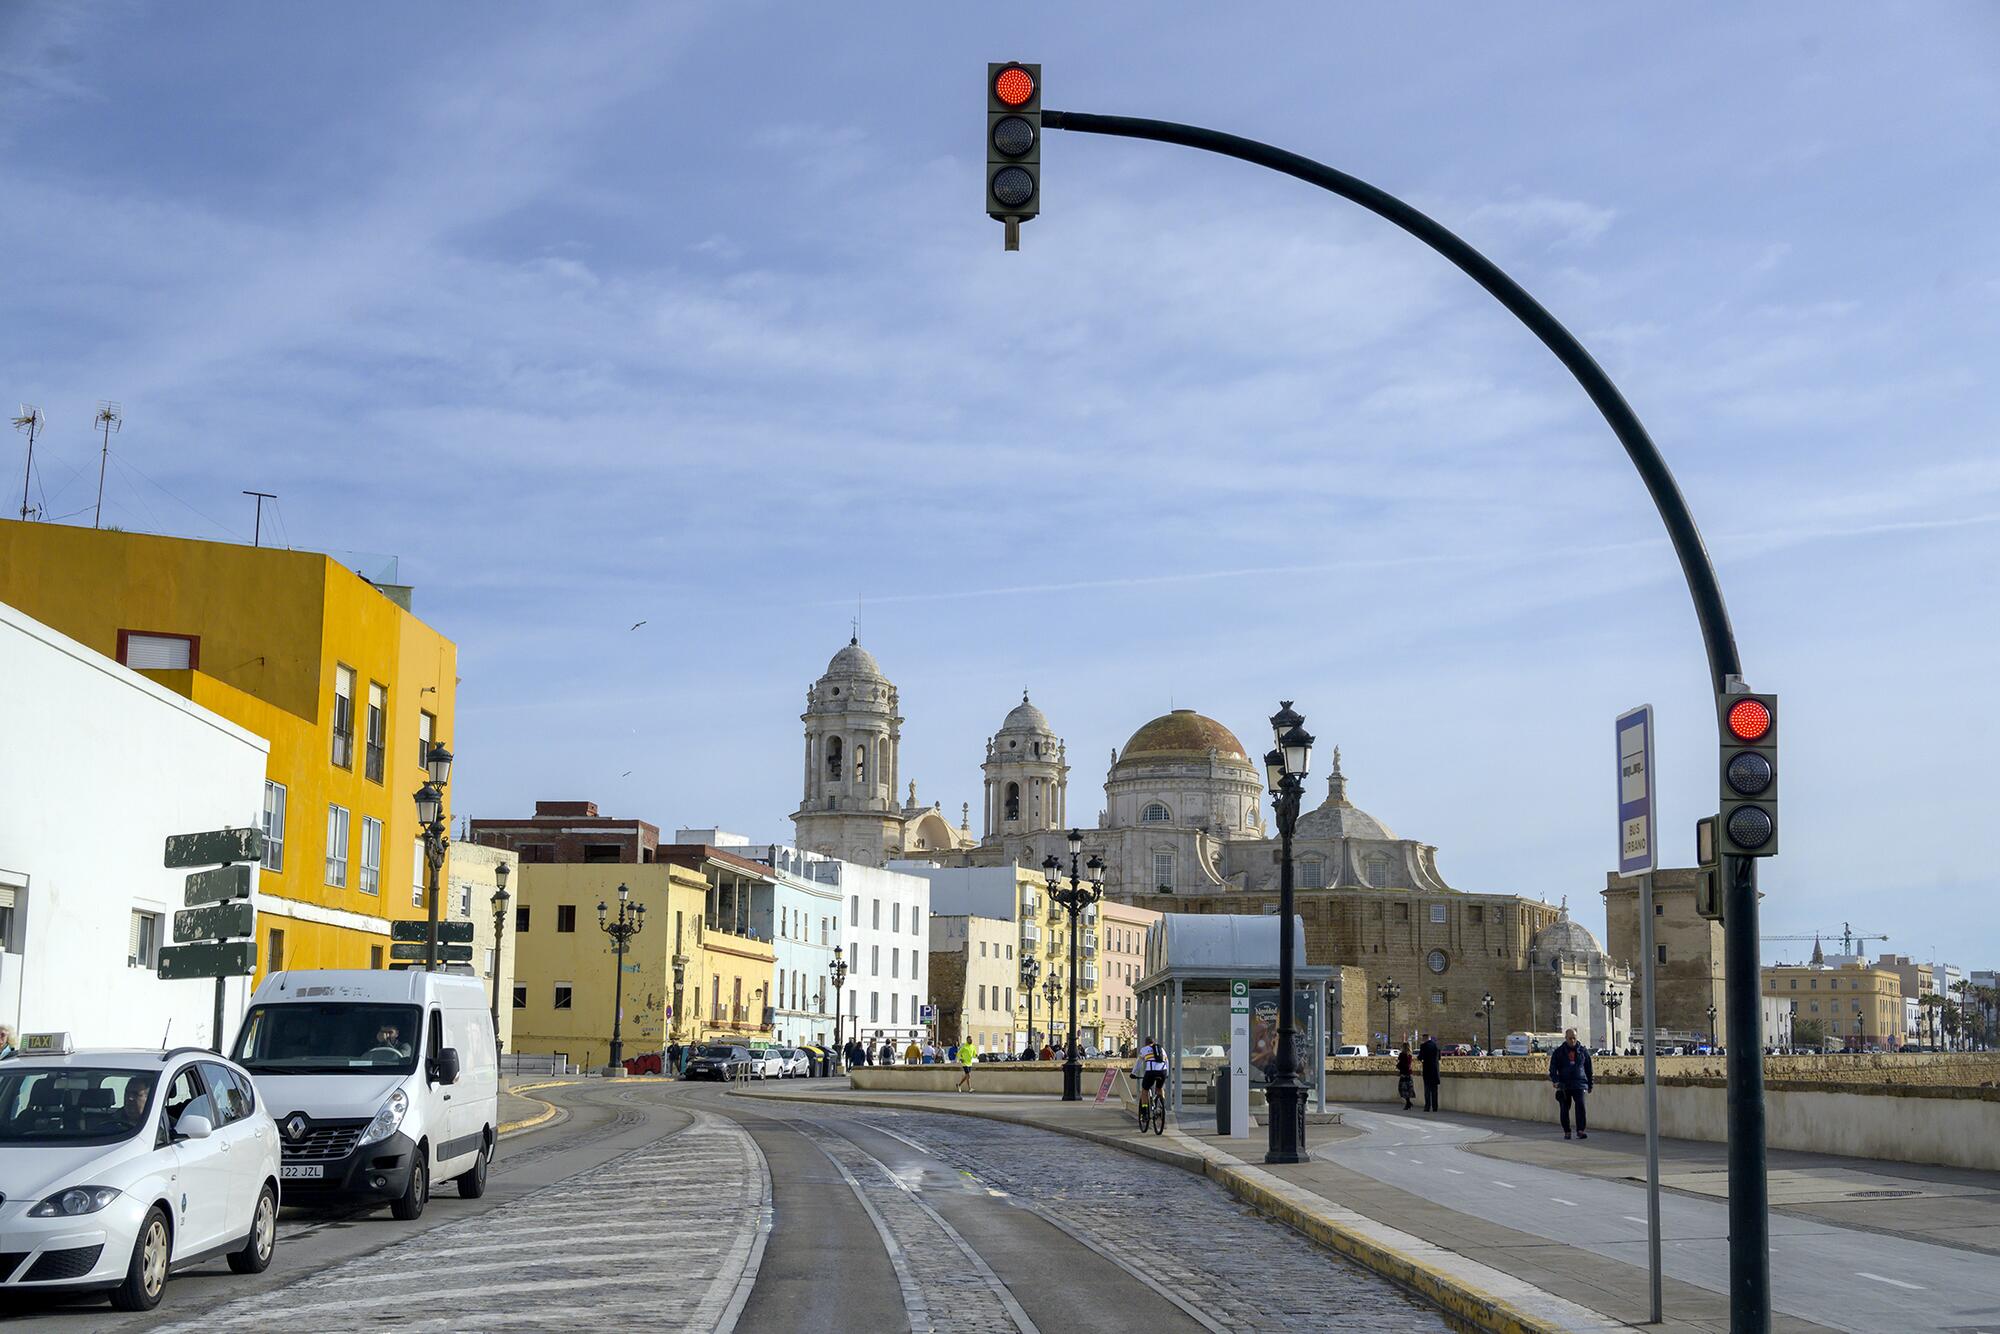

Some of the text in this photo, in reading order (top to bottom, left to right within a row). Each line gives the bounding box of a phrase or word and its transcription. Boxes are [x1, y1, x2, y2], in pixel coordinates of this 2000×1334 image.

[1629, 823, 1640, 836] BUS
[1625, 837, 1646, 854] URBANO
[923, 1005, 932, 1016] P
[31, 1036, 52, 1048] TAXI
[301, 1167, 321, 1177] JZL
